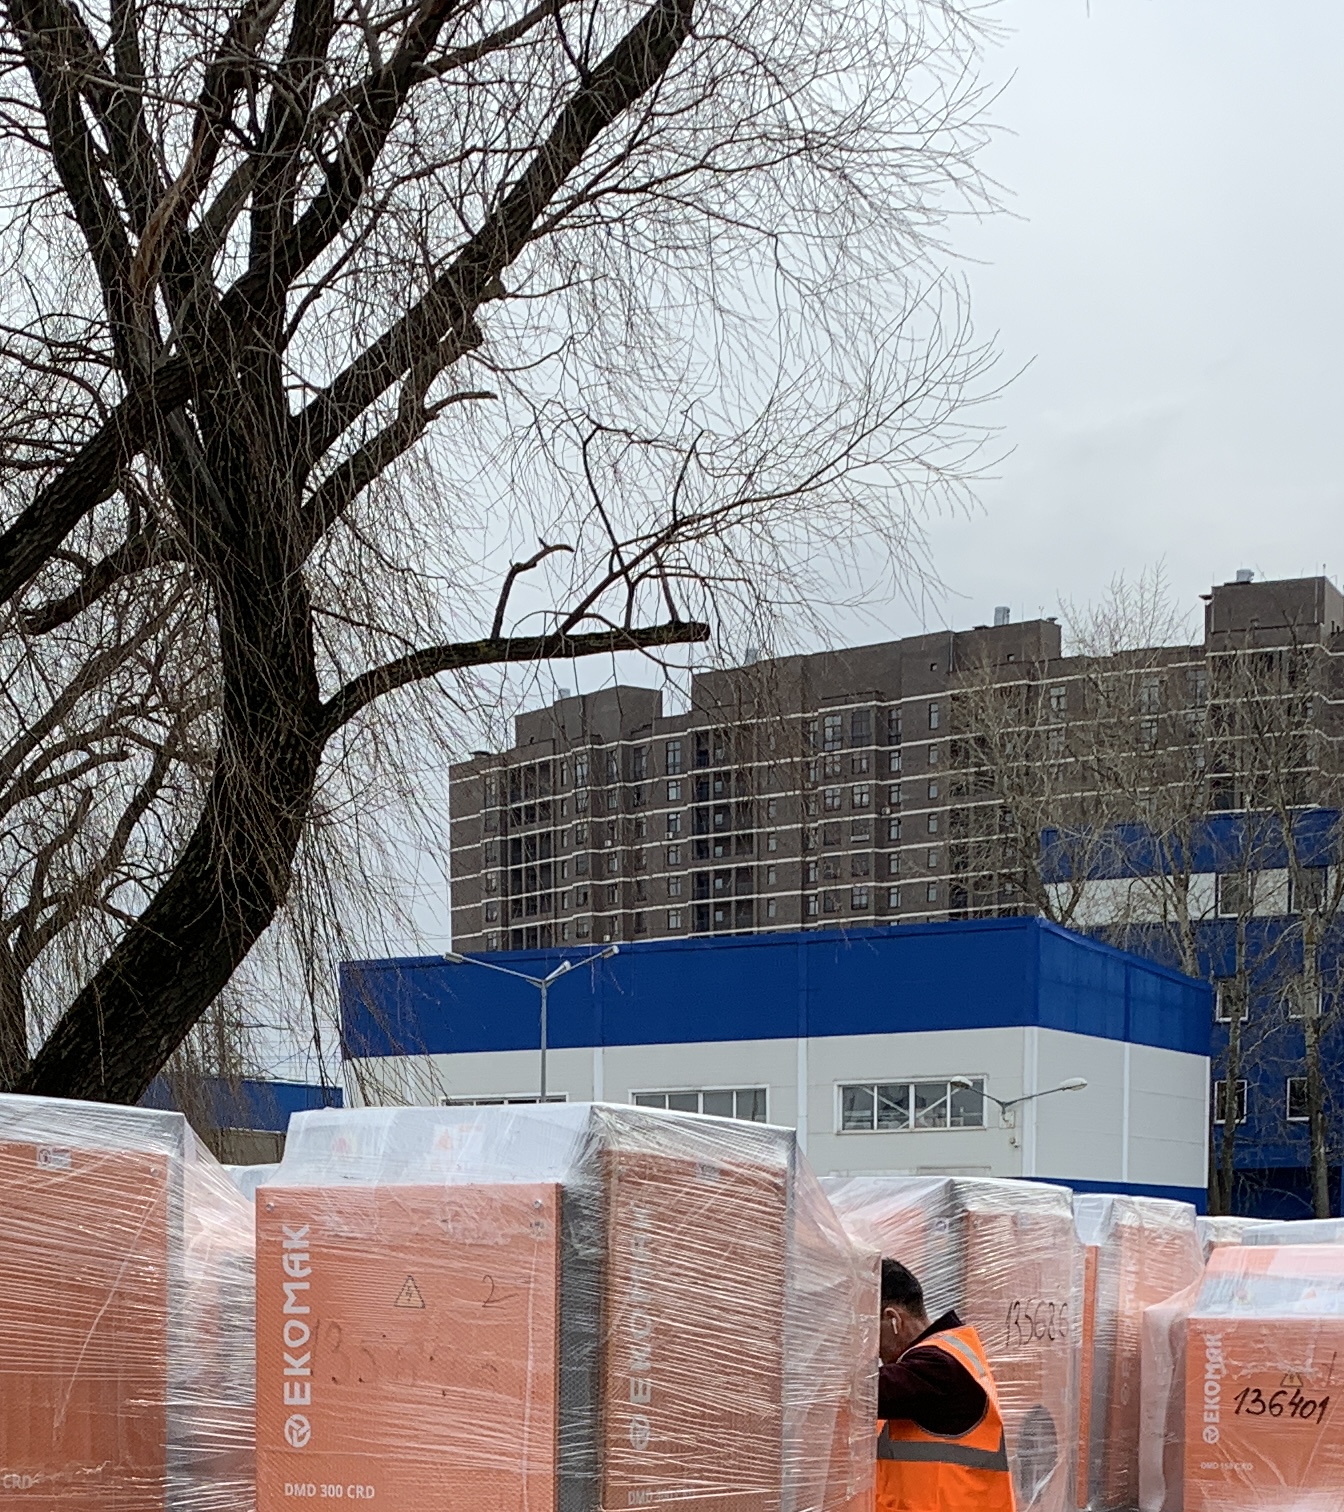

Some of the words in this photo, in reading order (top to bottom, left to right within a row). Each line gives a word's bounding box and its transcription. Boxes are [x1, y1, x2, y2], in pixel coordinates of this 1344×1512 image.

[482, 1275, 520, 1309] 2
[282, 1225, 312, 1405] EKOMAK
[1203, 1334, 1227, 1423] EKOMAK
[1233, 1387, 1331, 1424] 136401
[3, 1474, 33, 1489] CRD
[285, 1483, 316, 1496] DMD
[320, 1484, 343, 1497] 300
[347, 1485, 375, 1498] CRD
